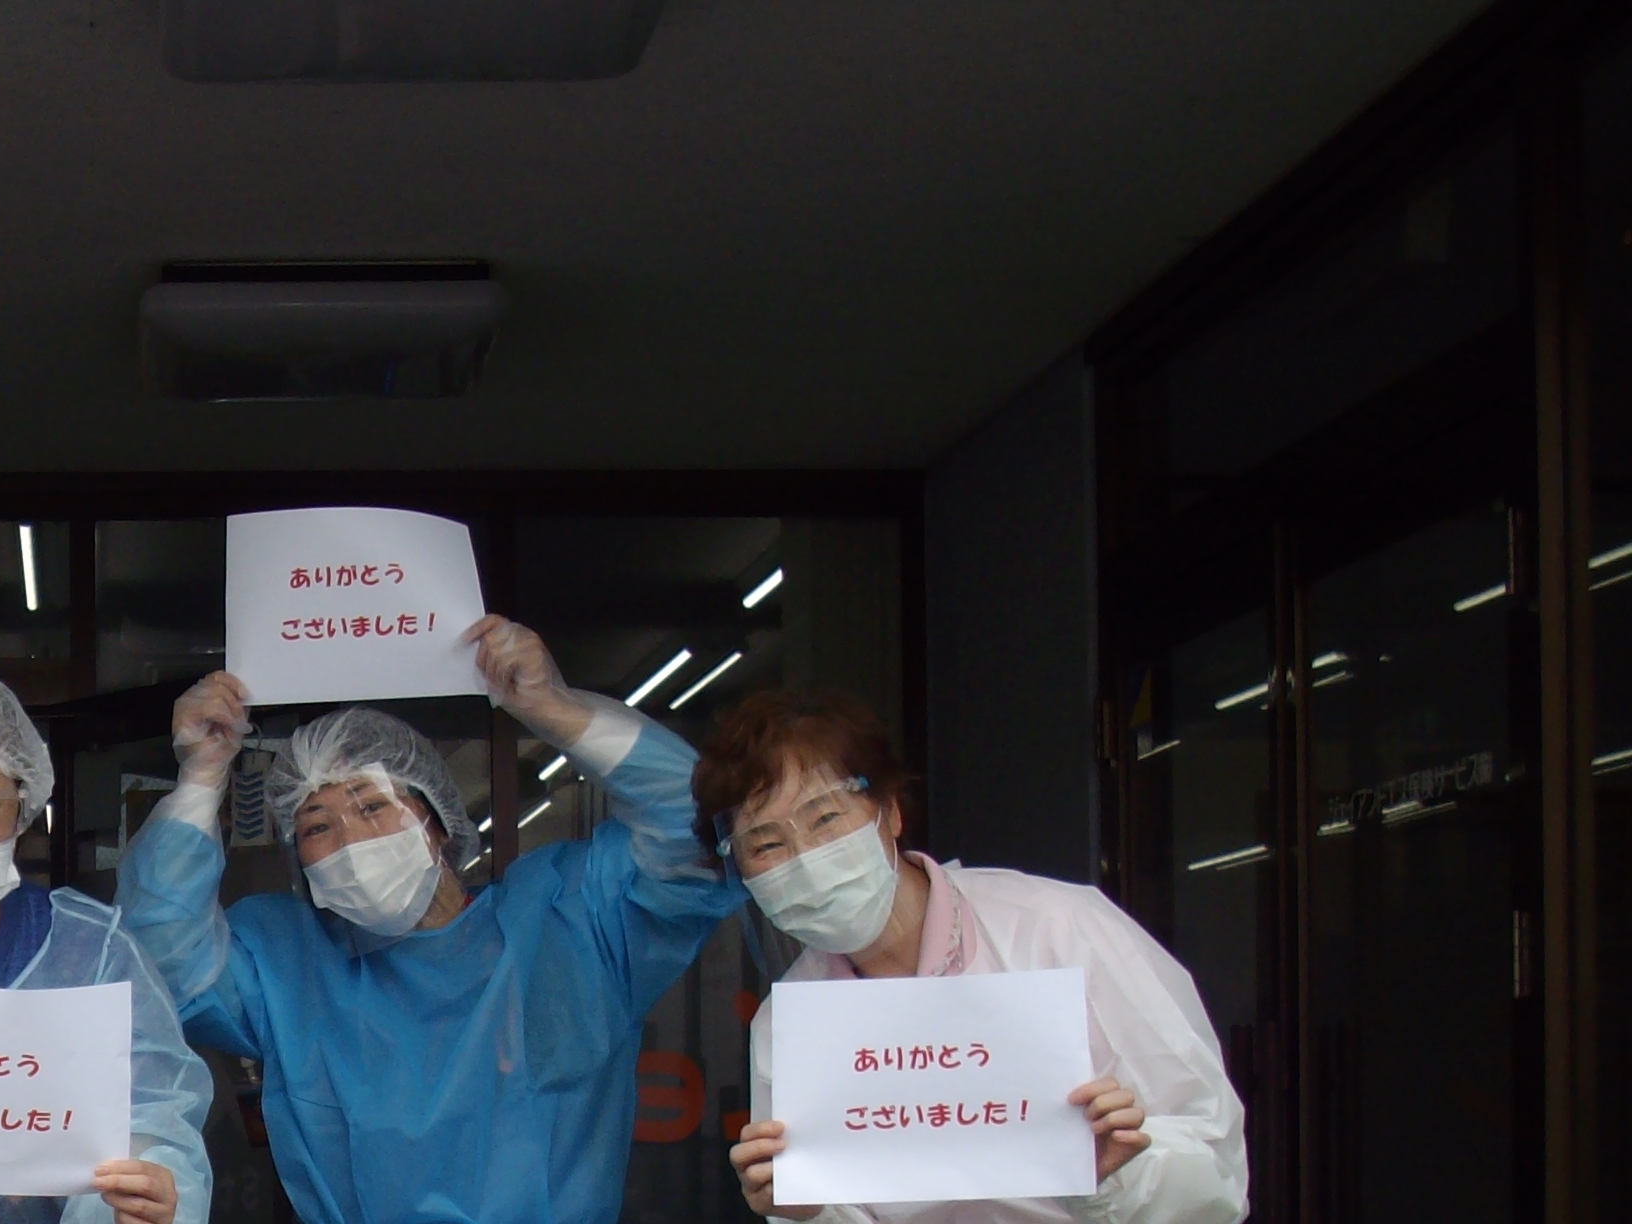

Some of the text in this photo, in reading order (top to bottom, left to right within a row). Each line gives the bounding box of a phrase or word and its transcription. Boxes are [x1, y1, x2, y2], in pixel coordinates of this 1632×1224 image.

[290, 566, 403, 589] ありがとう
[853, 1043, 990, 1073] ありがとう
